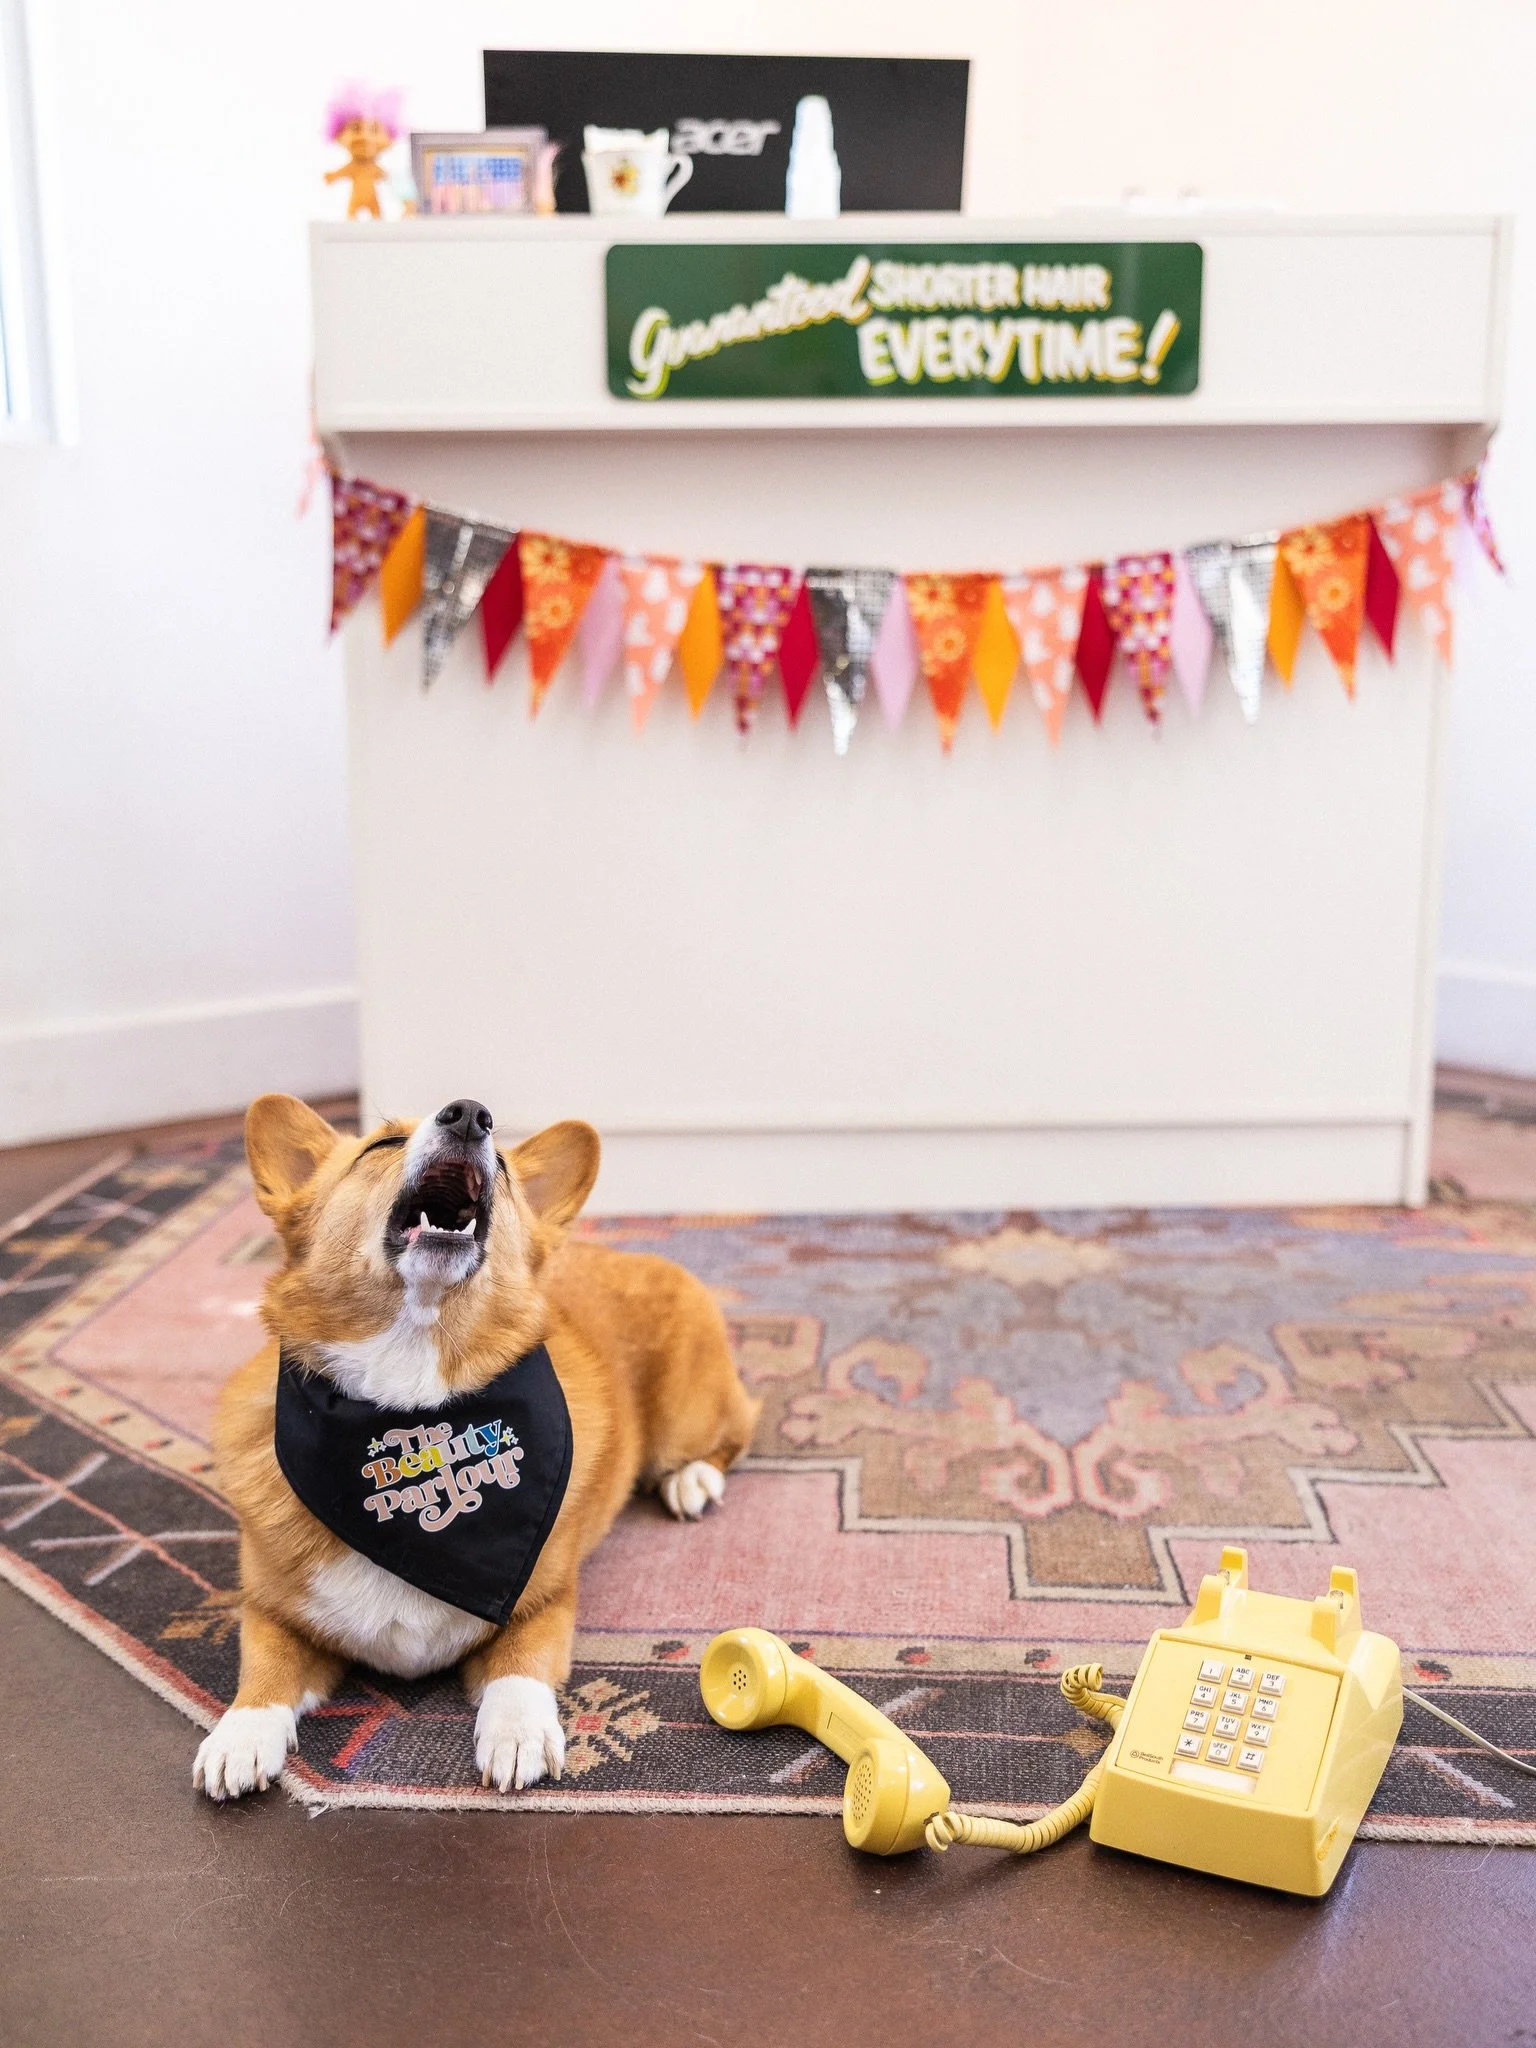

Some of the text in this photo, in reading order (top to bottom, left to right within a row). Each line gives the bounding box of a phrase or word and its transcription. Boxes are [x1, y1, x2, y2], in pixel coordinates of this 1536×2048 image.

[669, 117, 782, 156] acer
[868, 261, 1021, 312] SHORTER
[1021, 263, 1112, 312] HAIR
[857, 308, 1181, 386] EVERYTIME!
[361, 1419, 502, 1490] Beauty
[383, 1422, 453, 1455] The
[363, 1446, 525, 1532] Parlour
[1236, 1667, 1250, 1675] ABC
[1266, 1673, 1280, 1681] DEF
[1199, 1685, 1212, 1693] GHI
[1190, 1709, 1204, 1717] PRS
[1221, 1716, 1235, 1724] TUV
